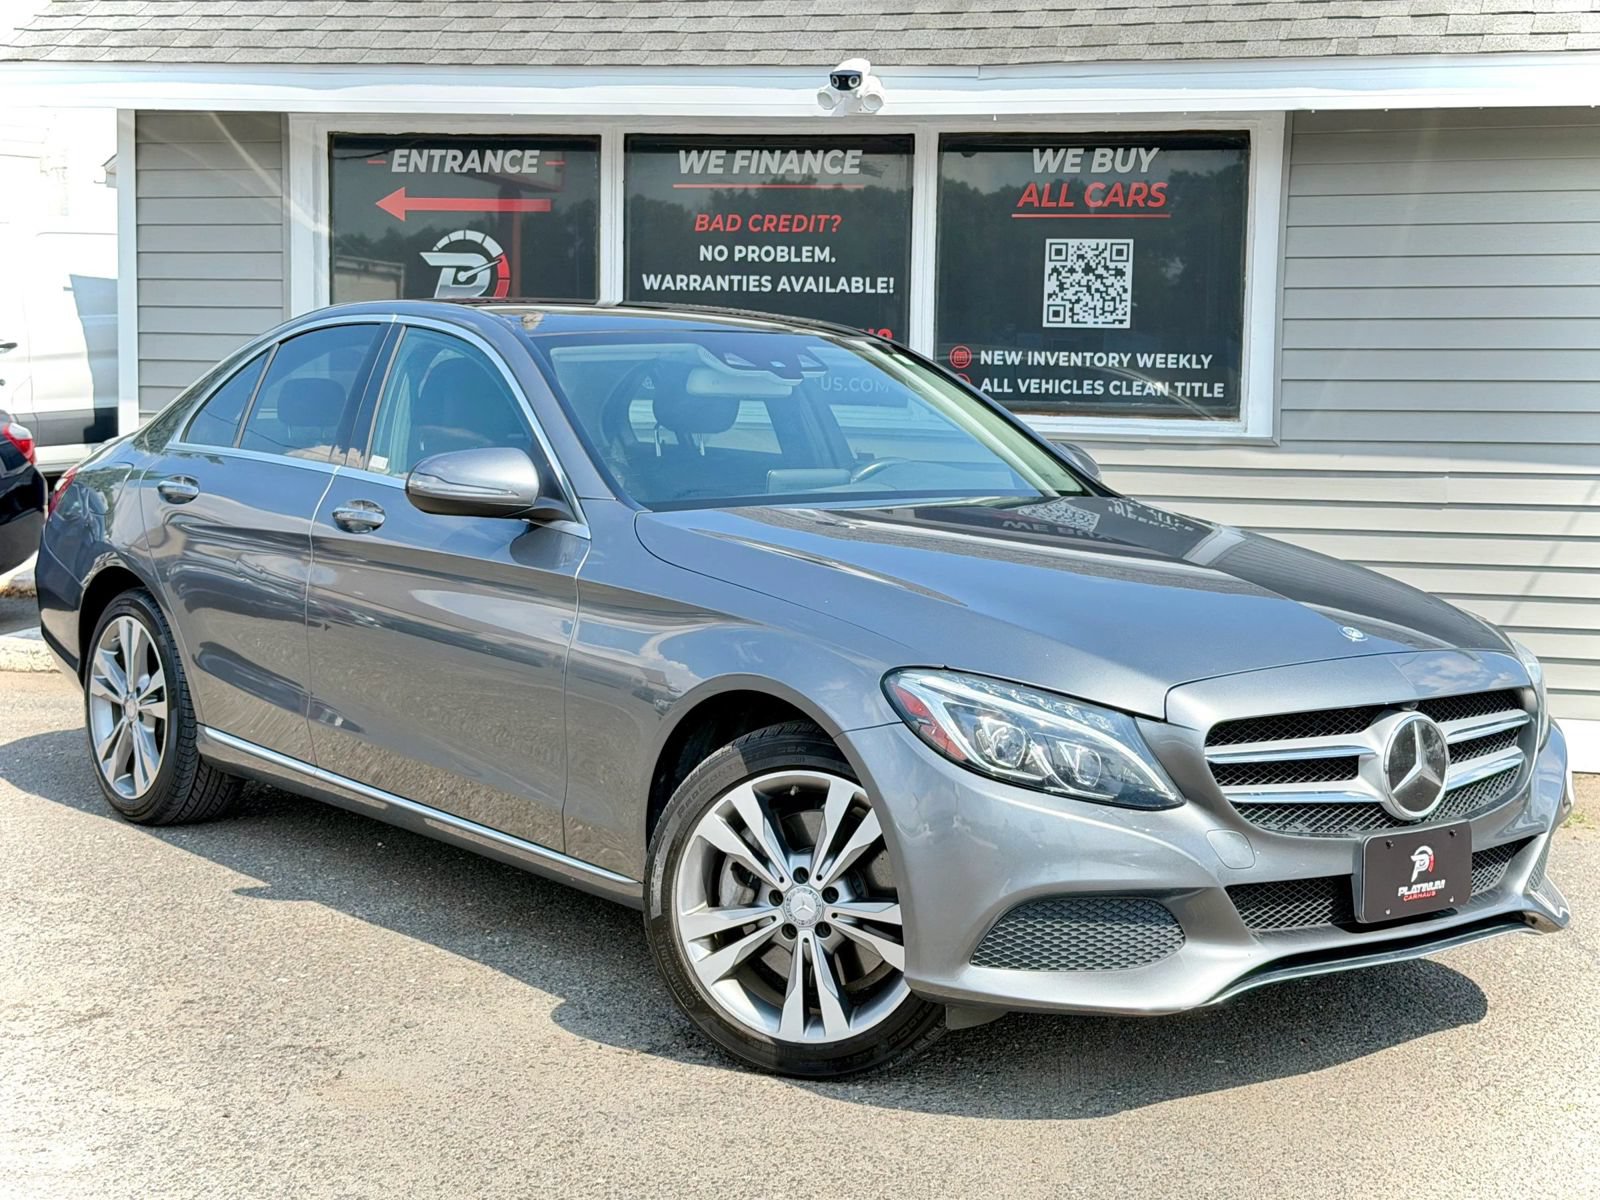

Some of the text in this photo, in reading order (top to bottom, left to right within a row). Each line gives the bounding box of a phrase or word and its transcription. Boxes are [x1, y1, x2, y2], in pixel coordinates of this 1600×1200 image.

[391, 149, 541, 174] ENTRANCE
[678, 149, 863, 175] WE FINANCE
[1033, 147, 1160, 174] WE BUY
[1017, 182, 1168, 208] ALL CARS
[694, 213, 842, 233] BAD CREDIT?
[699, 245, 836, 263] NO PROBLEM.
[642, 274, 895, 294] WARRANTIES AVAILABLE!
[980, 350, 1213, 369] NEW INVENTORY WEEKLY
[980, 378, 1225, 398] ALL VEHICLES CLEAN TITLE
[1397, 879, 1446, 896] PLATINUM
